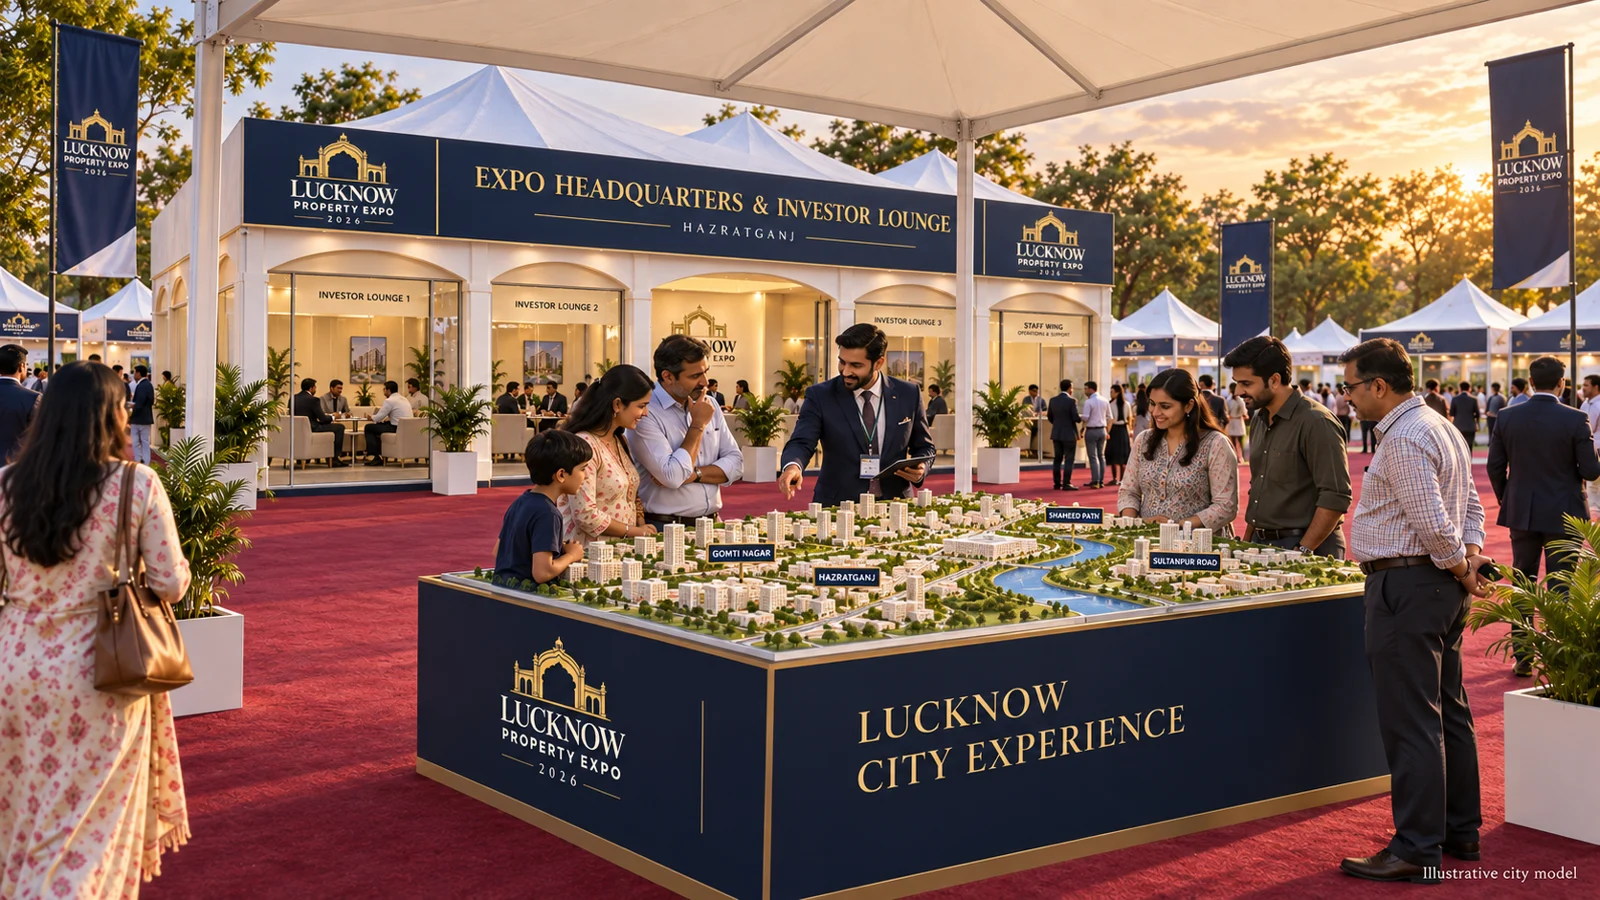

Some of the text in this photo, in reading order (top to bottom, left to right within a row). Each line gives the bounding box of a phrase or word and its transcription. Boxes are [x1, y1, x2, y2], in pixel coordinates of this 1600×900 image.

[63, 140, 131, 160] LUCKNOW
[64, 155, 129, 169] PROPERTY EXPO
[1497, 155, 1563, 176] LUCKNOW
[84, 168, 107, 176] 2026
[1498, 171, 1562, 186] PROPERTY EXPO
[290, 179, 398, 204] LUCKNOW
[1519, 185, 1541, 193] 2026
[475, 166, 951, 233] EXPO HEADQUARTERS & INVESTOR LOUNGE
[294, 200, 394, 216] PROPERTY EXPO
[327, 215, 361, 225] 2026
[683, 222, 795, 242] HAZRATGANJ
[1016, 242, 1085, 261] LUCKNOW
[1018, 258, 1083, 270] PROPERTY EXPO
[319, 291, 364, 300] INVESTOR
[367, 293, 403, 302] LOUNGE
[515, 301, 555, 309] INVESTOR
[558, 302, 591, 311] LOUNGE
[909, 318, 935, 326] LOUNGE
[712, 549, 771, 558] GOMTI NAGAR
[1153, 557, 1218, 567] SULTANPUR ROAD
[818, 573, 876, 582] HAZRATGANJ
[859, 680, 1068, 744] LUCKNOW
[500, 695, 626, 759] LUCKNOW
[502, 727, 621, 781] PROPERTY EXPO
[857, 704, 1186, 793] CITY EXPERIENCE
[538, 762, 578, 787] 2026
